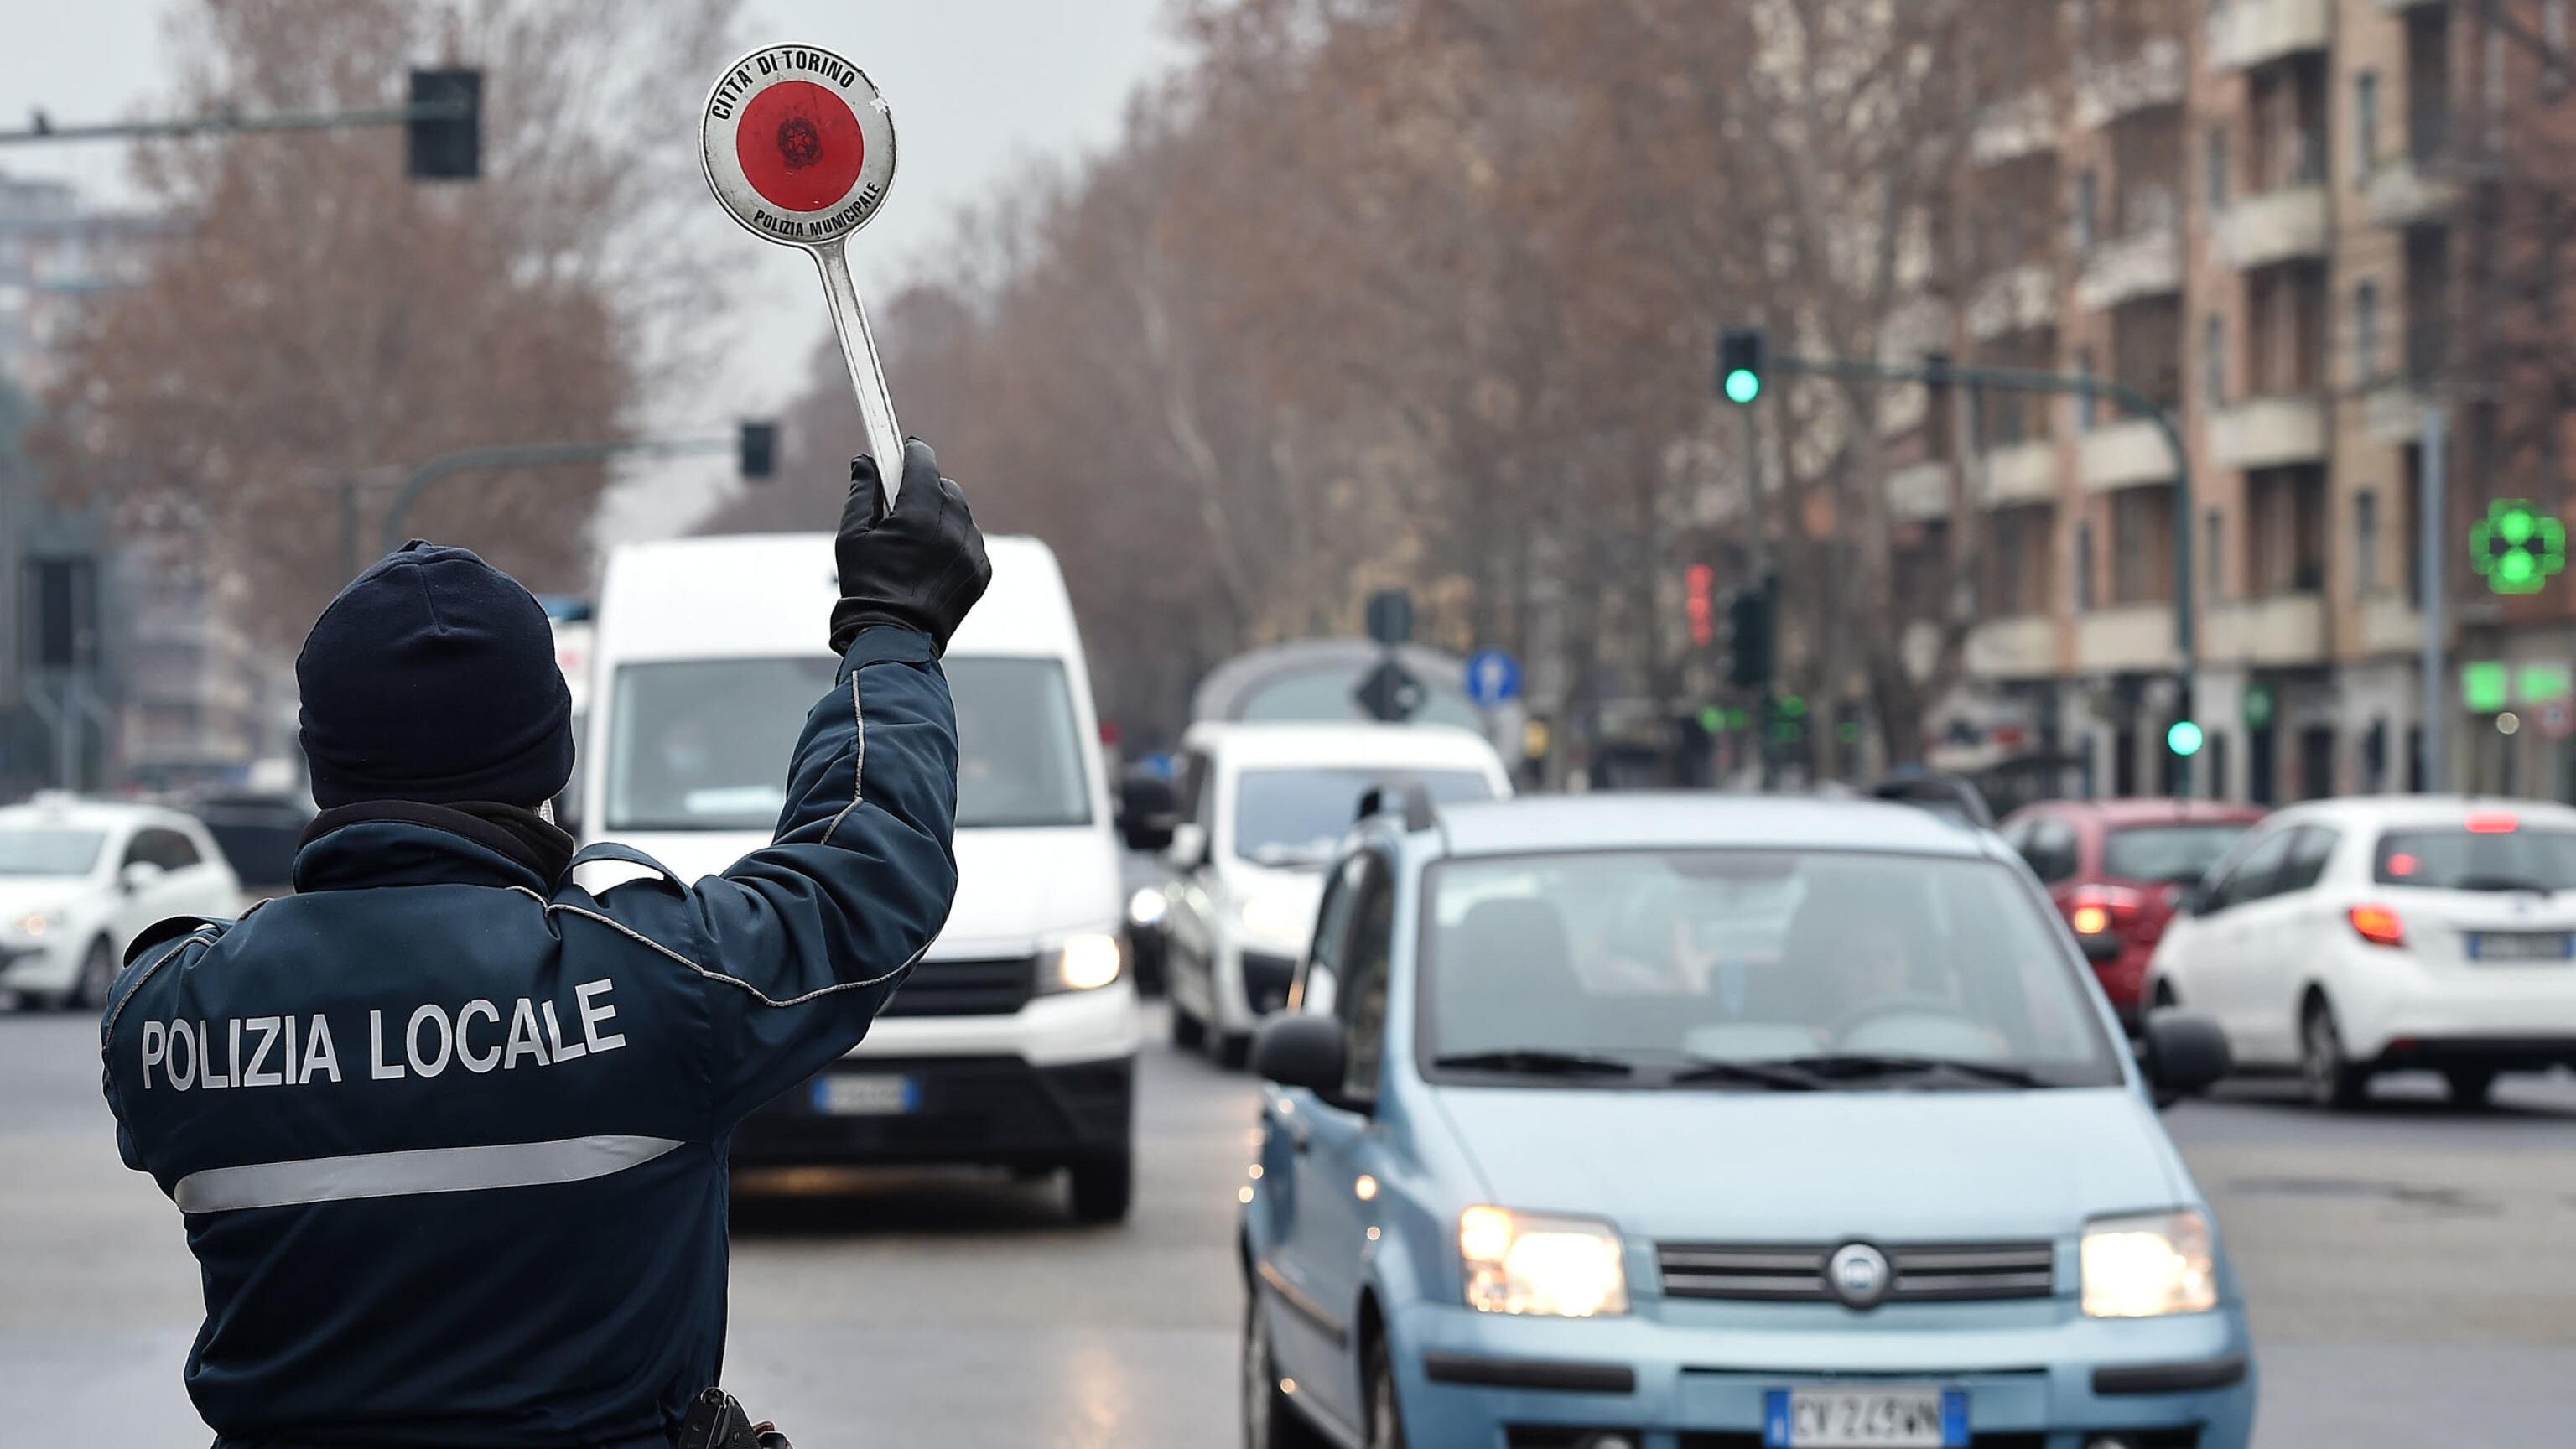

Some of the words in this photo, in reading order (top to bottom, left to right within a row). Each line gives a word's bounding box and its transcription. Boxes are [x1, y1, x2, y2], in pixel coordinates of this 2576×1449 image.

[712, 64, 754, 120] CITTA'
[756, 53, 778, 75] DI
[782, 50, 855, 88] TORINO
[753, 209, 804, 236] POLIZIA
[809, 181, 880, 236] MUNICIPALE
[141, 1013, 342, 1091] POLIZIA
[370, 978, 626, 1081] LOCALE
